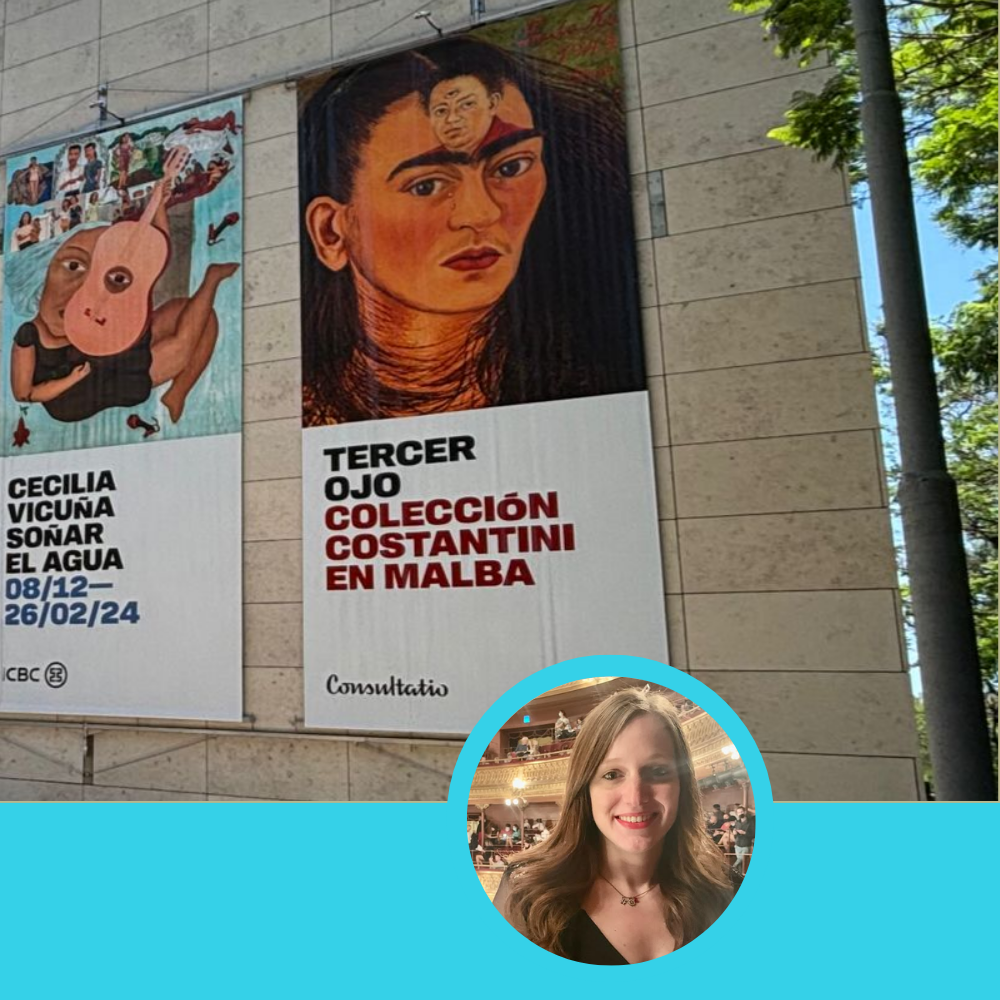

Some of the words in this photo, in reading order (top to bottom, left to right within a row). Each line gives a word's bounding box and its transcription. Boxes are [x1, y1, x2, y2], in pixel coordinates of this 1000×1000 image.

[323, 435, 477, 472] TERCER
[8, 470, 117, 499] CECILIA
[324, 472, 401, 501] OJO
[8, 496, 116, 524] VICUÑA
[324, 491, 560, 531] COLECCIÓN
[6, 523, 104, 549] SOÑAR
[324, 523, 576, 561] COSTANTINI
[6, 552, 36, 574] EL
[42, 548, 124, 573] AGUA
[326, 564, 374, 591] EN
[384, 558, 536, 590] MALBA
[4, 600, 140, 628] 26/02/24
[326, 673, 449, 698] Consultatio
